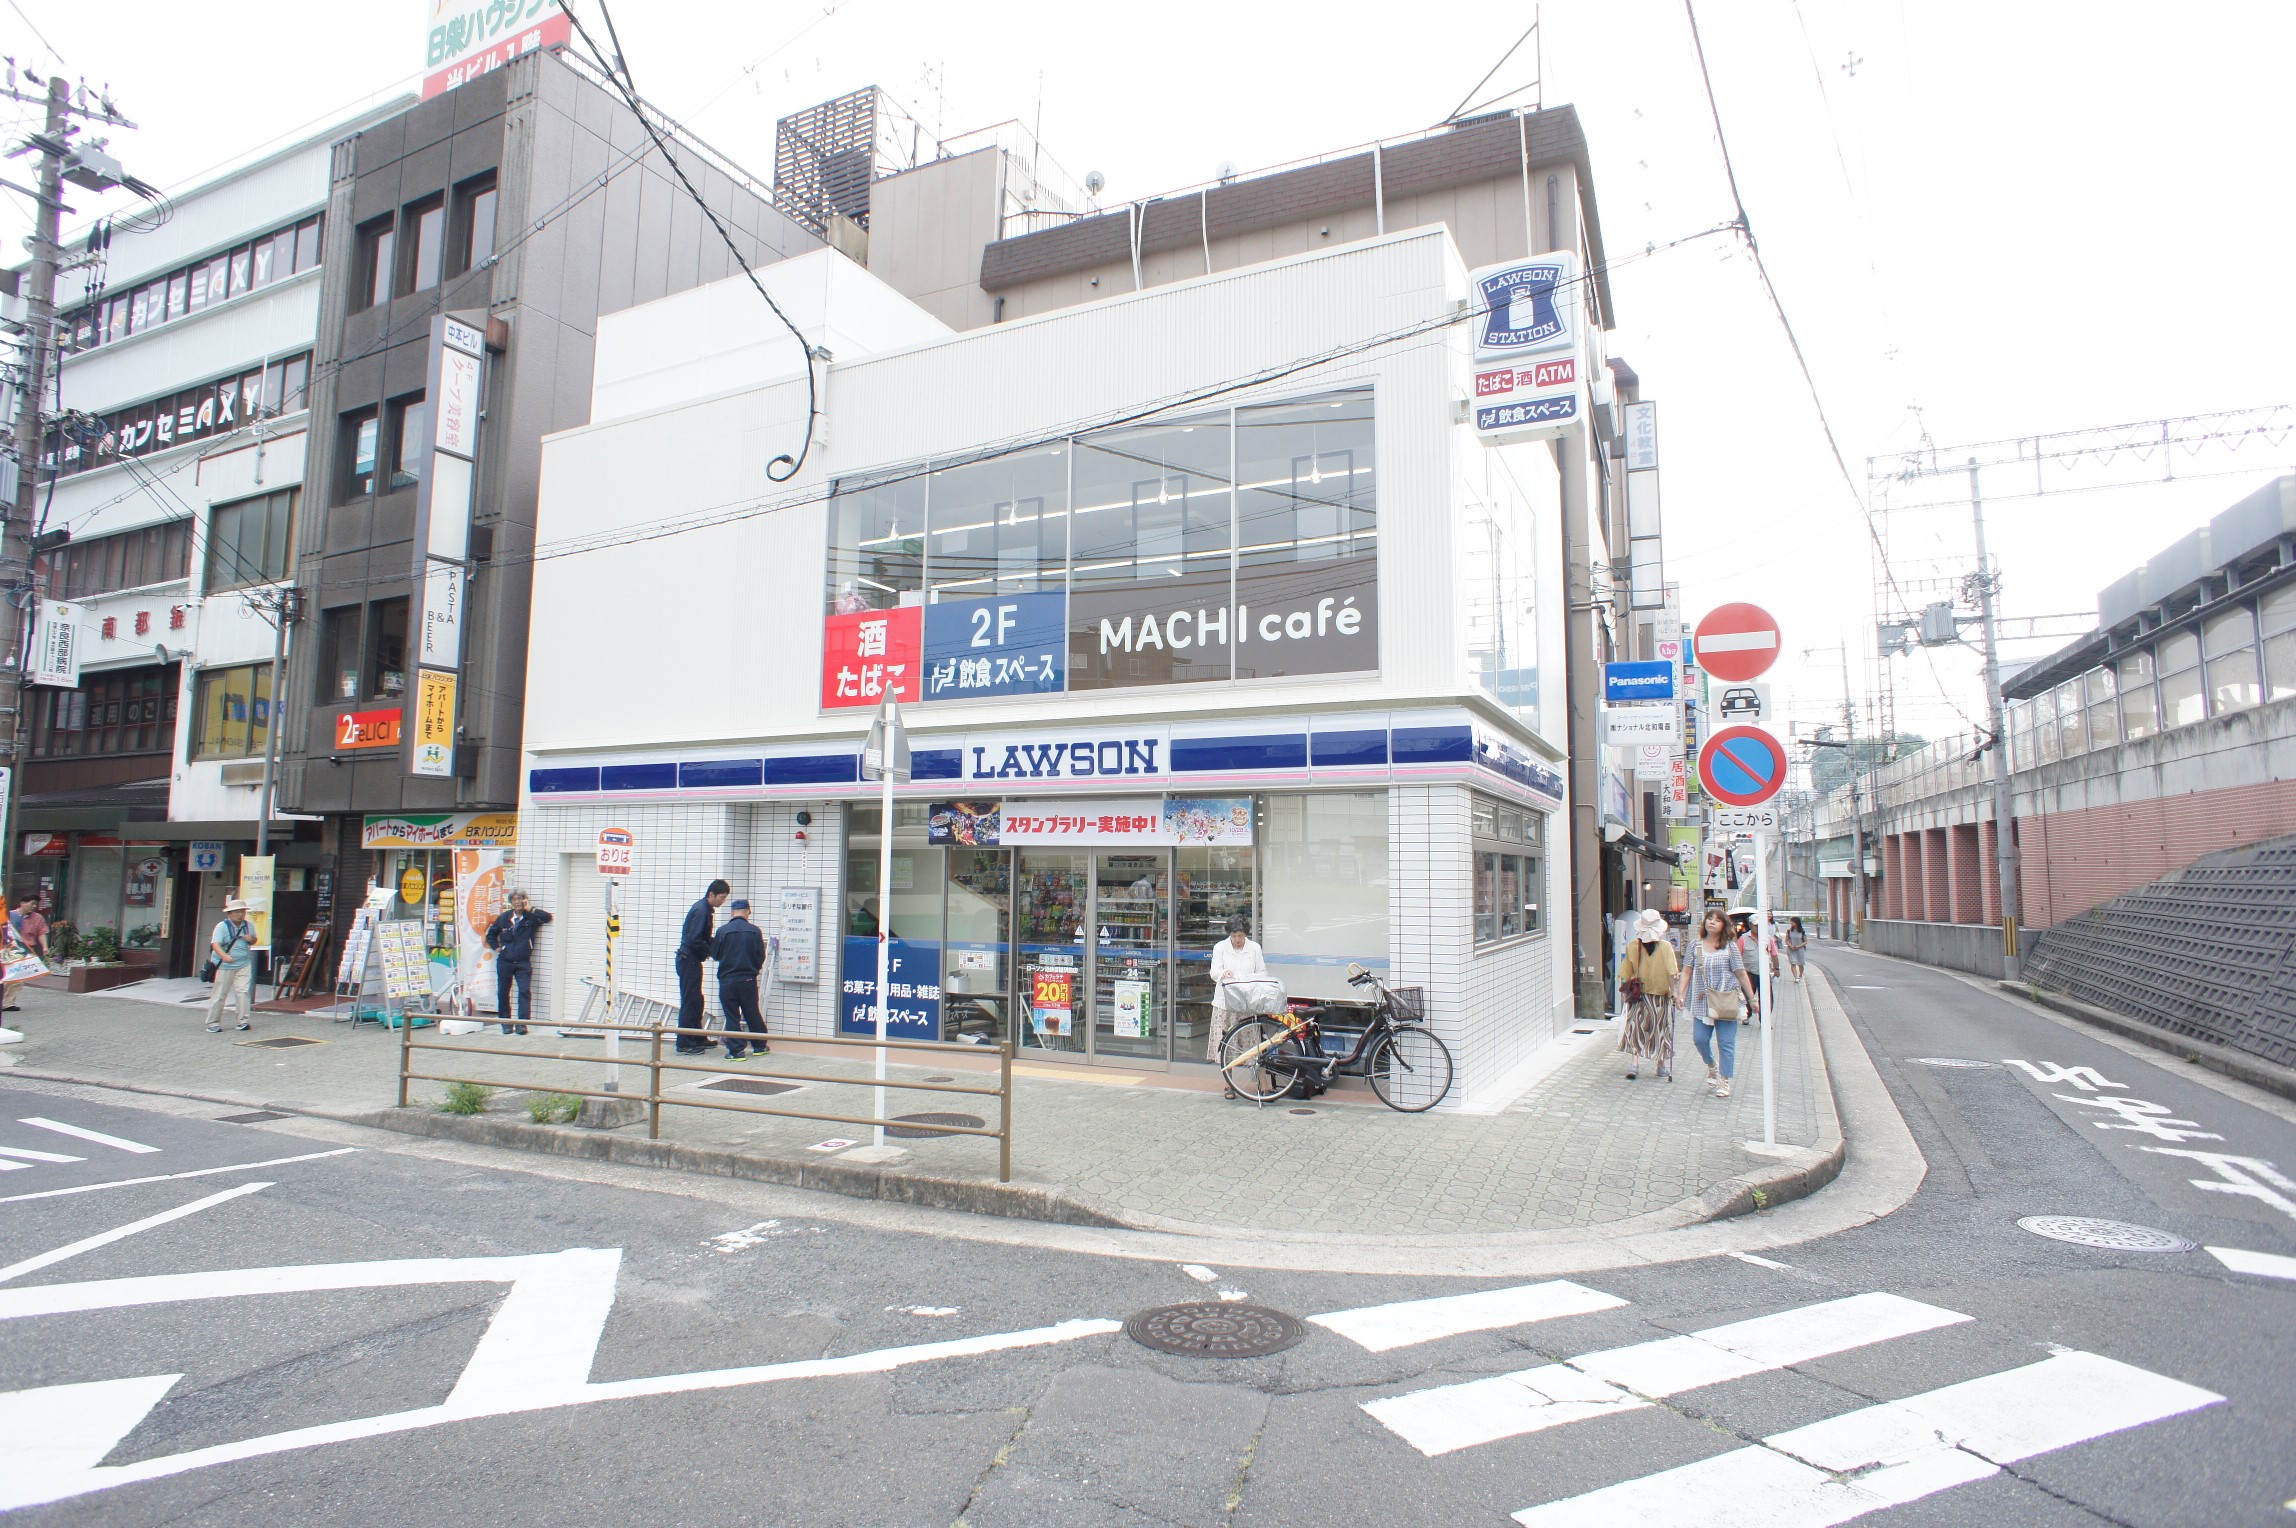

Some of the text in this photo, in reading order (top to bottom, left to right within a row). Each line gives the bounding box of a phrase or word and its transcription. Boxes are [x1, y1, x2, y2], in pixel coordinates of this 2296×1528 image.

[1485, 269, 1556, 293] LAWSON
[448, 324, 478, 350] 中本ビル
[1488, 321, 1557, 345] STATION
[1477, 363, 1573, 393] たばこ 酒 ATM
[1498, 400, 1573, 424] 飲食スペース
[447, 571, 457, 624] PASTA
[426, 610, 434, 653] BEER
[436, 612, 445, 623] &
[971, 604, 1018, 648] 2F
[1100, 595, 1362, 655] MACHI café
[56, 622, 71, 675] 奈良西部病院
[857, 619, 888, 658] 酒
[836, 664, 905, 698] たばこ
[959, 654, 1055, 689] 飲食スペース
[1608, 674, 1669, 687] Panasonic
[424, 684, 434, 740] マイホームまで
[436, 685, 446, 733] アパートから
[972, 738, 1159, 780] LAWSON
[1672, 760, 1685, 802] 居酒屋
[1662, 783, 1672, 816] 大和路
[365, 820, 454, 843] アパートからマイホームまで
[1005, 814, 1157, 834] スタンプラリー実施中!
[1718, 812, 1775, 828] ここから
[192, 842, 223, 850] KOBAN
[600, 848, 631, 863] おりば
[472, 884, 488, 928] 募集中
[1127, 968, 1138, 977] 24
[843, 979, 940, 1000] お菓子・用品・雑誌
[1036, 982, 1068, 1002] 20 円引
